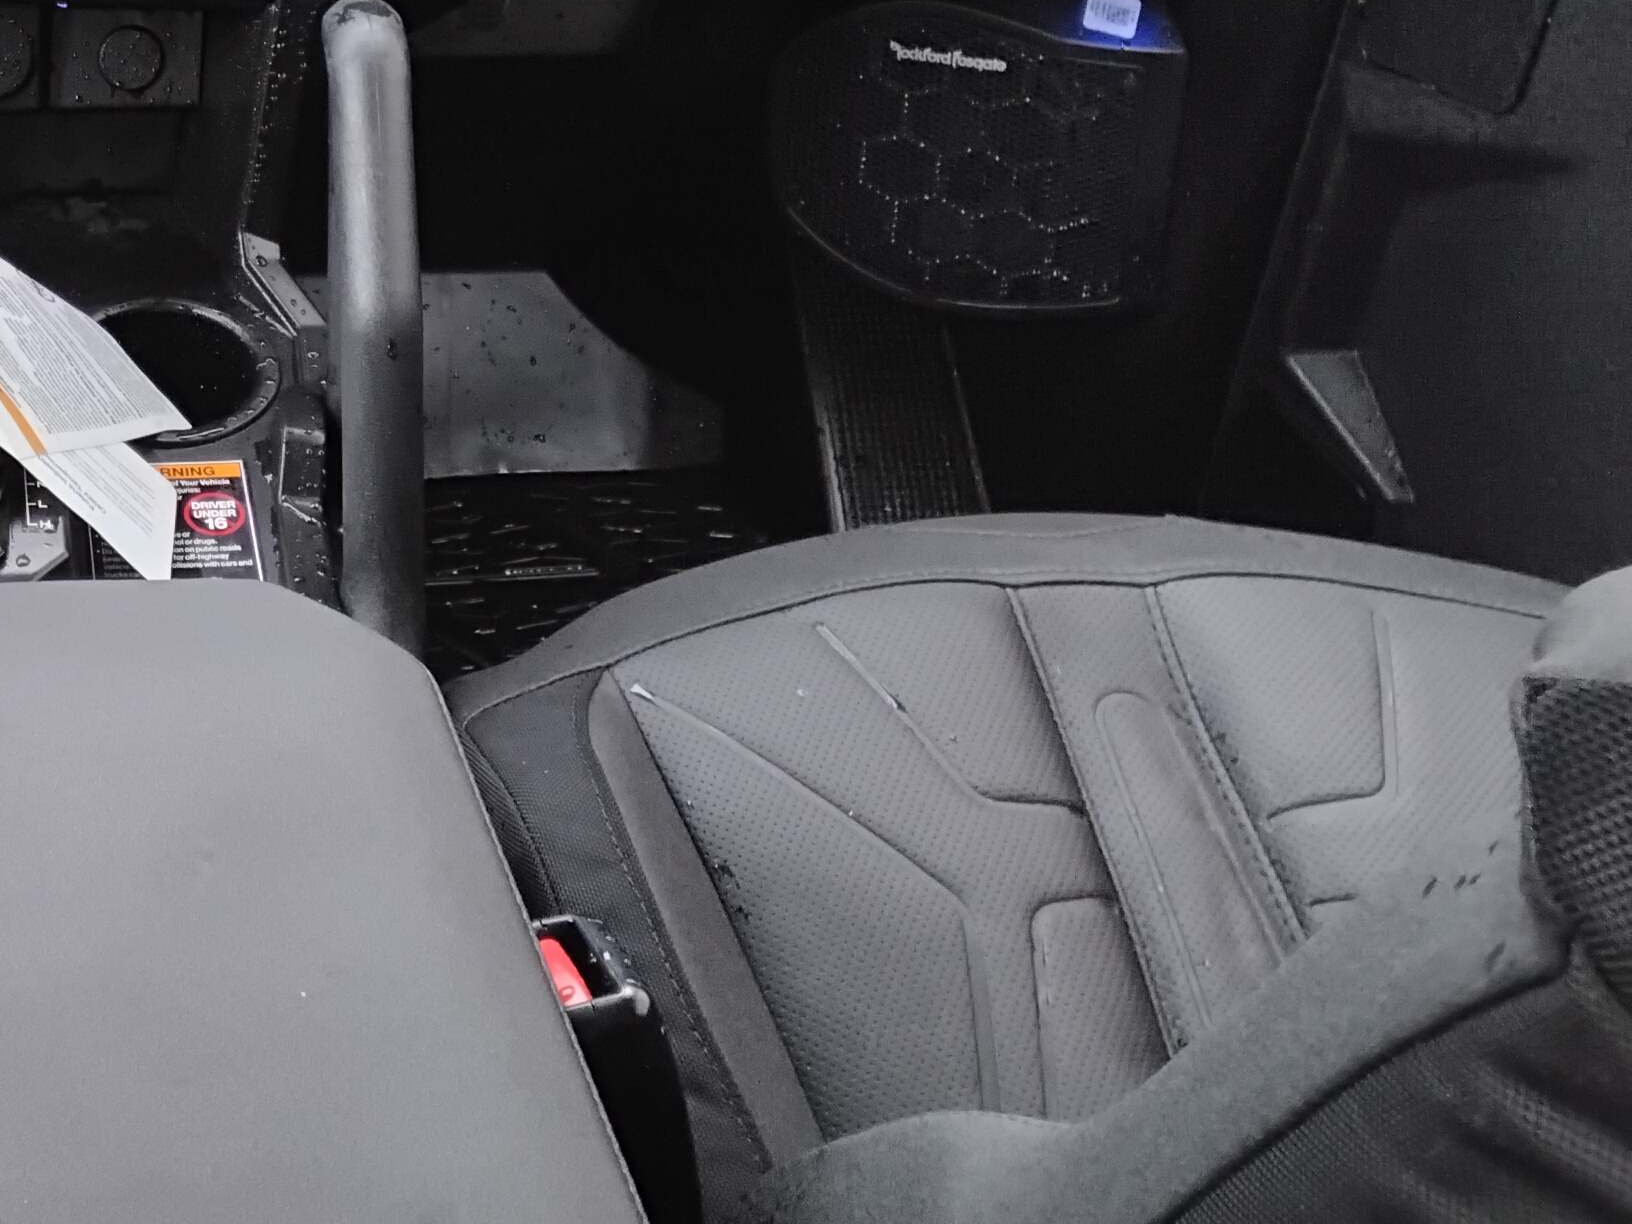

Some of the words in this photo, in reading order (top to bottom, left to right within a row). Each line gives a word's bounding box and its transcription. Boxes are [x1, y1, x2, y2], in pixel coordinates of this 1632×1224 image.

[160, 466, 215, 477] RNING
[199, 478, 231, 486] Vehicle
[38, 500, 48, 508] L
[191, 501, 236, 509] DRIVER
[193, 509, 237, 518] UNDER
[39, 519, 52, 529] H
[204, 518, 228, 530] 16
[185, 553, 229, 561] off-highway
